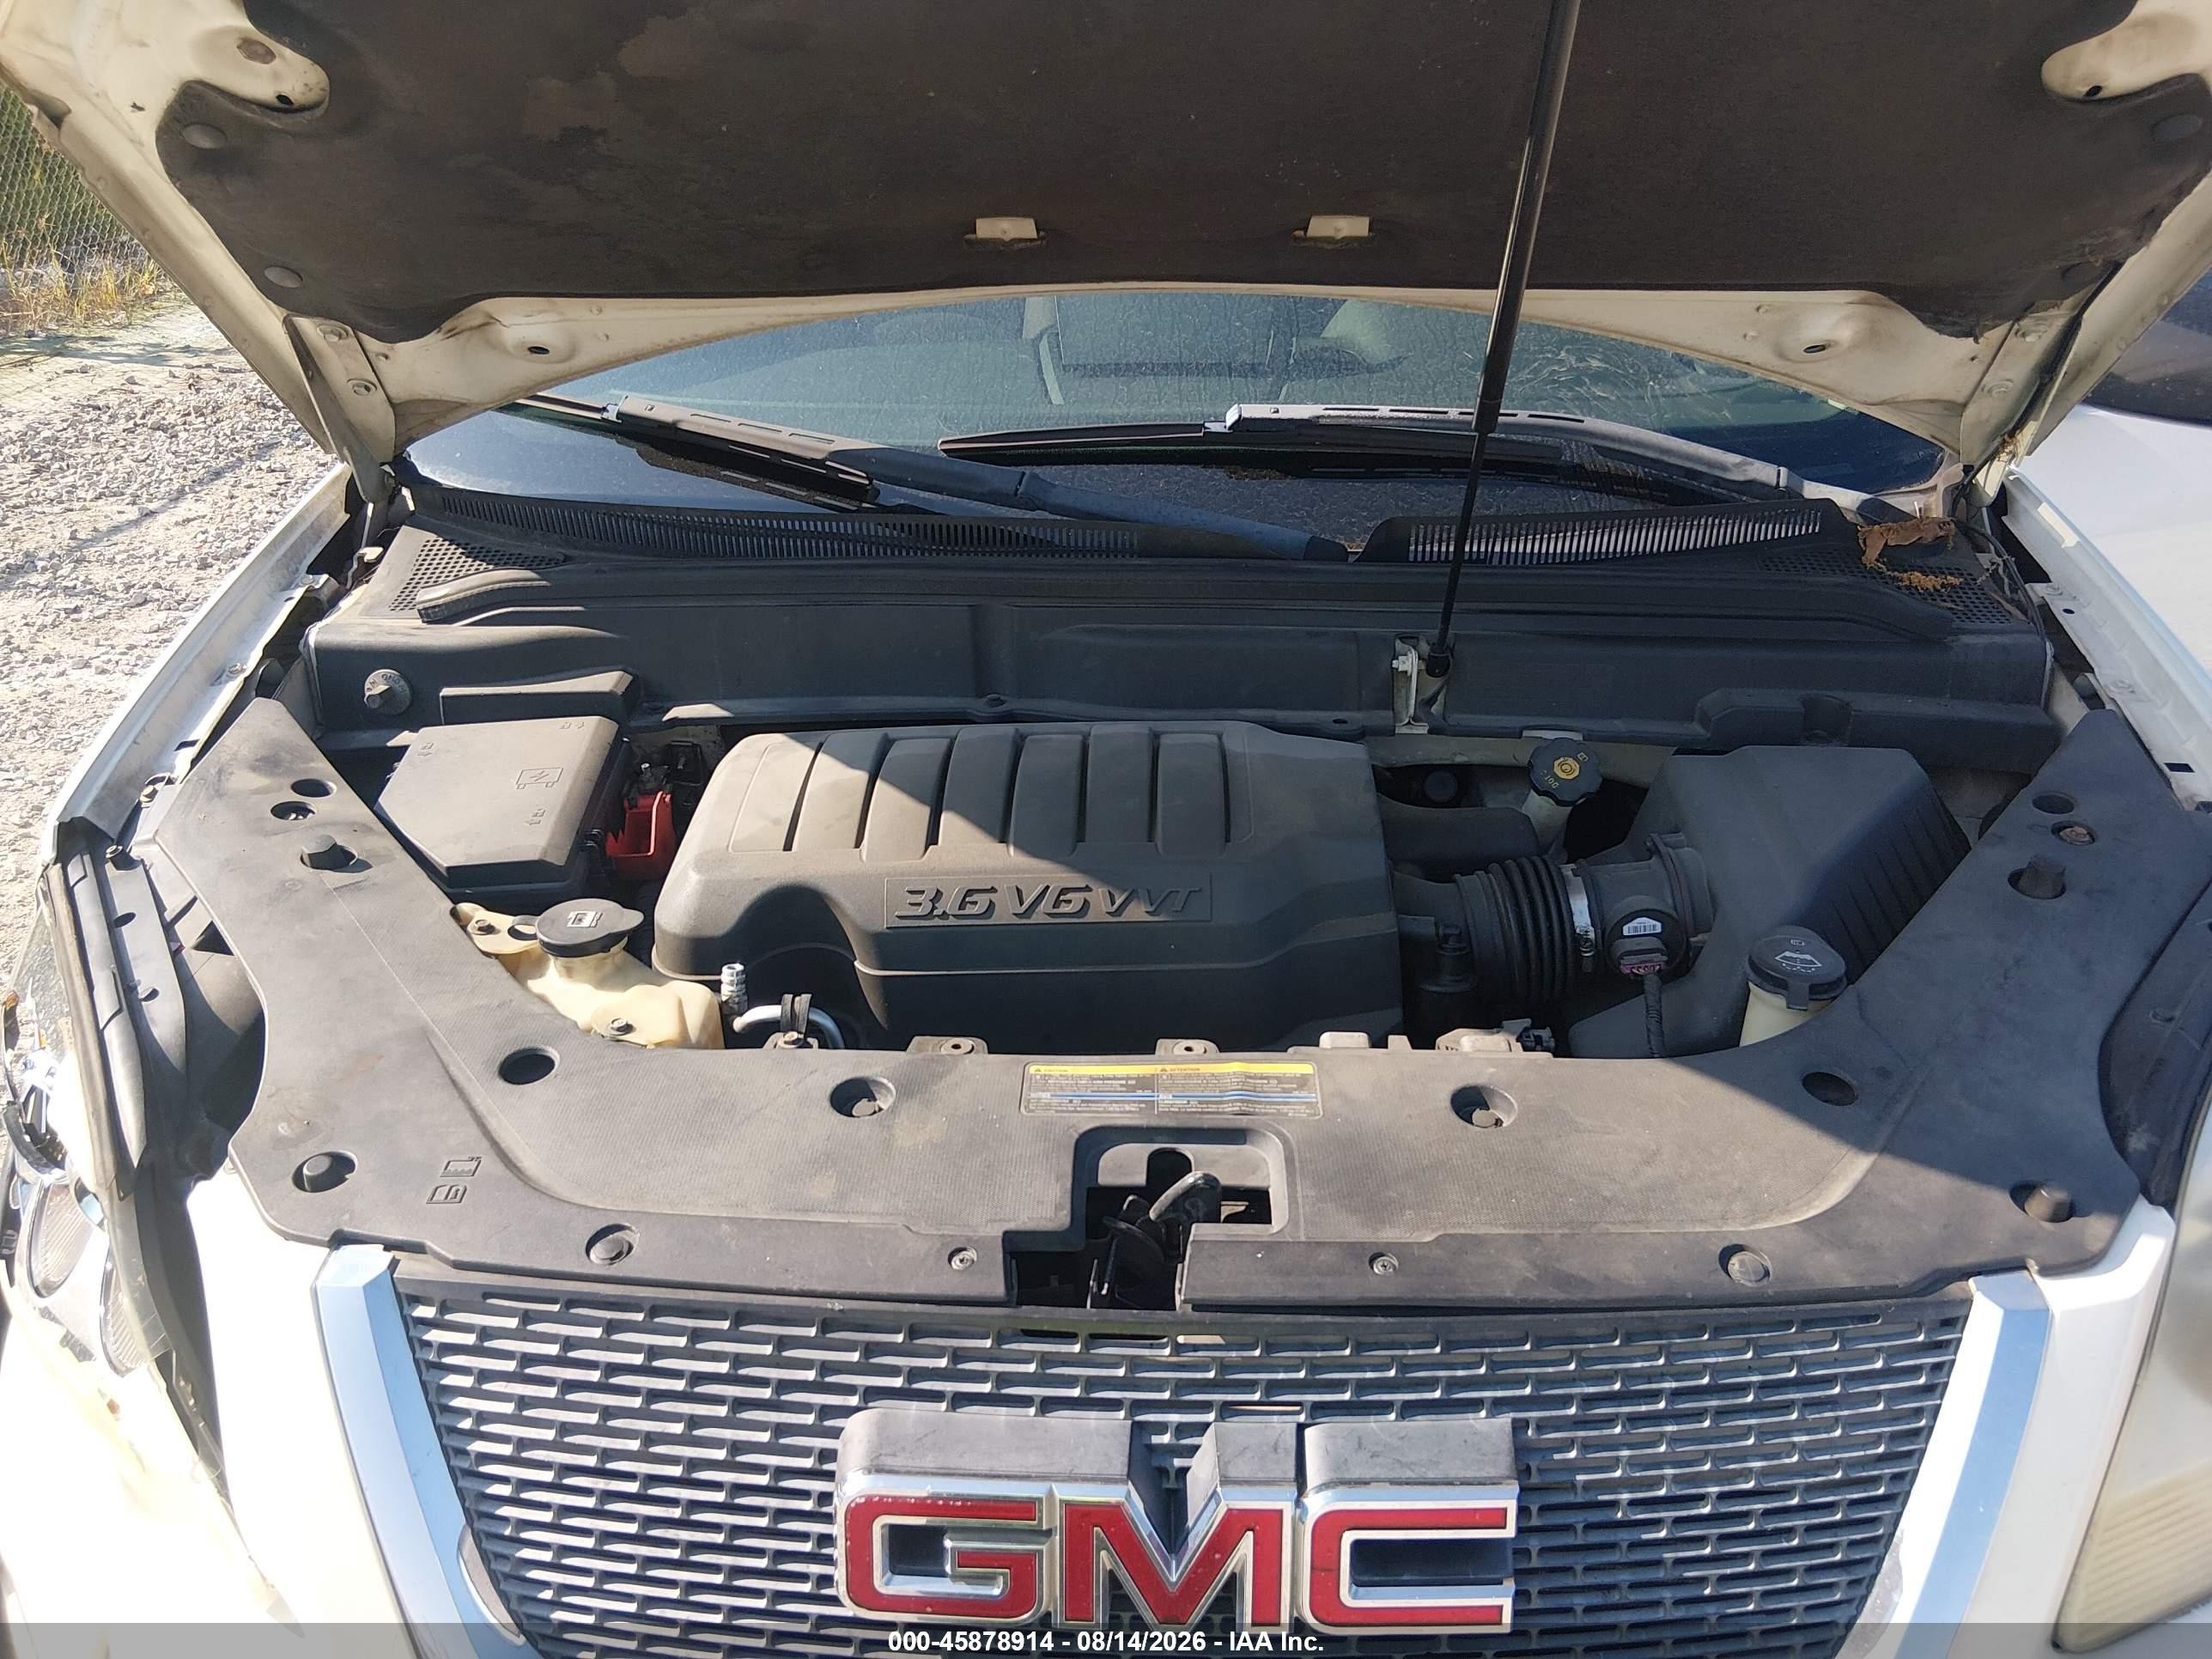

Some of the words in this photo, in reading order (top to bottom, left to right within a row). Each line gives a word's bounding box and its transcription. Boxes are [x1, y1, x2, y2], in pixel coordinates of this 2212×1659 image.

[895, 885, 998, 920] 3.6
[1004, 884, 1091, 919] V6
[1097, 886, 1204, 917] VVT
[836, 1463, 1519, 1635] GMC
